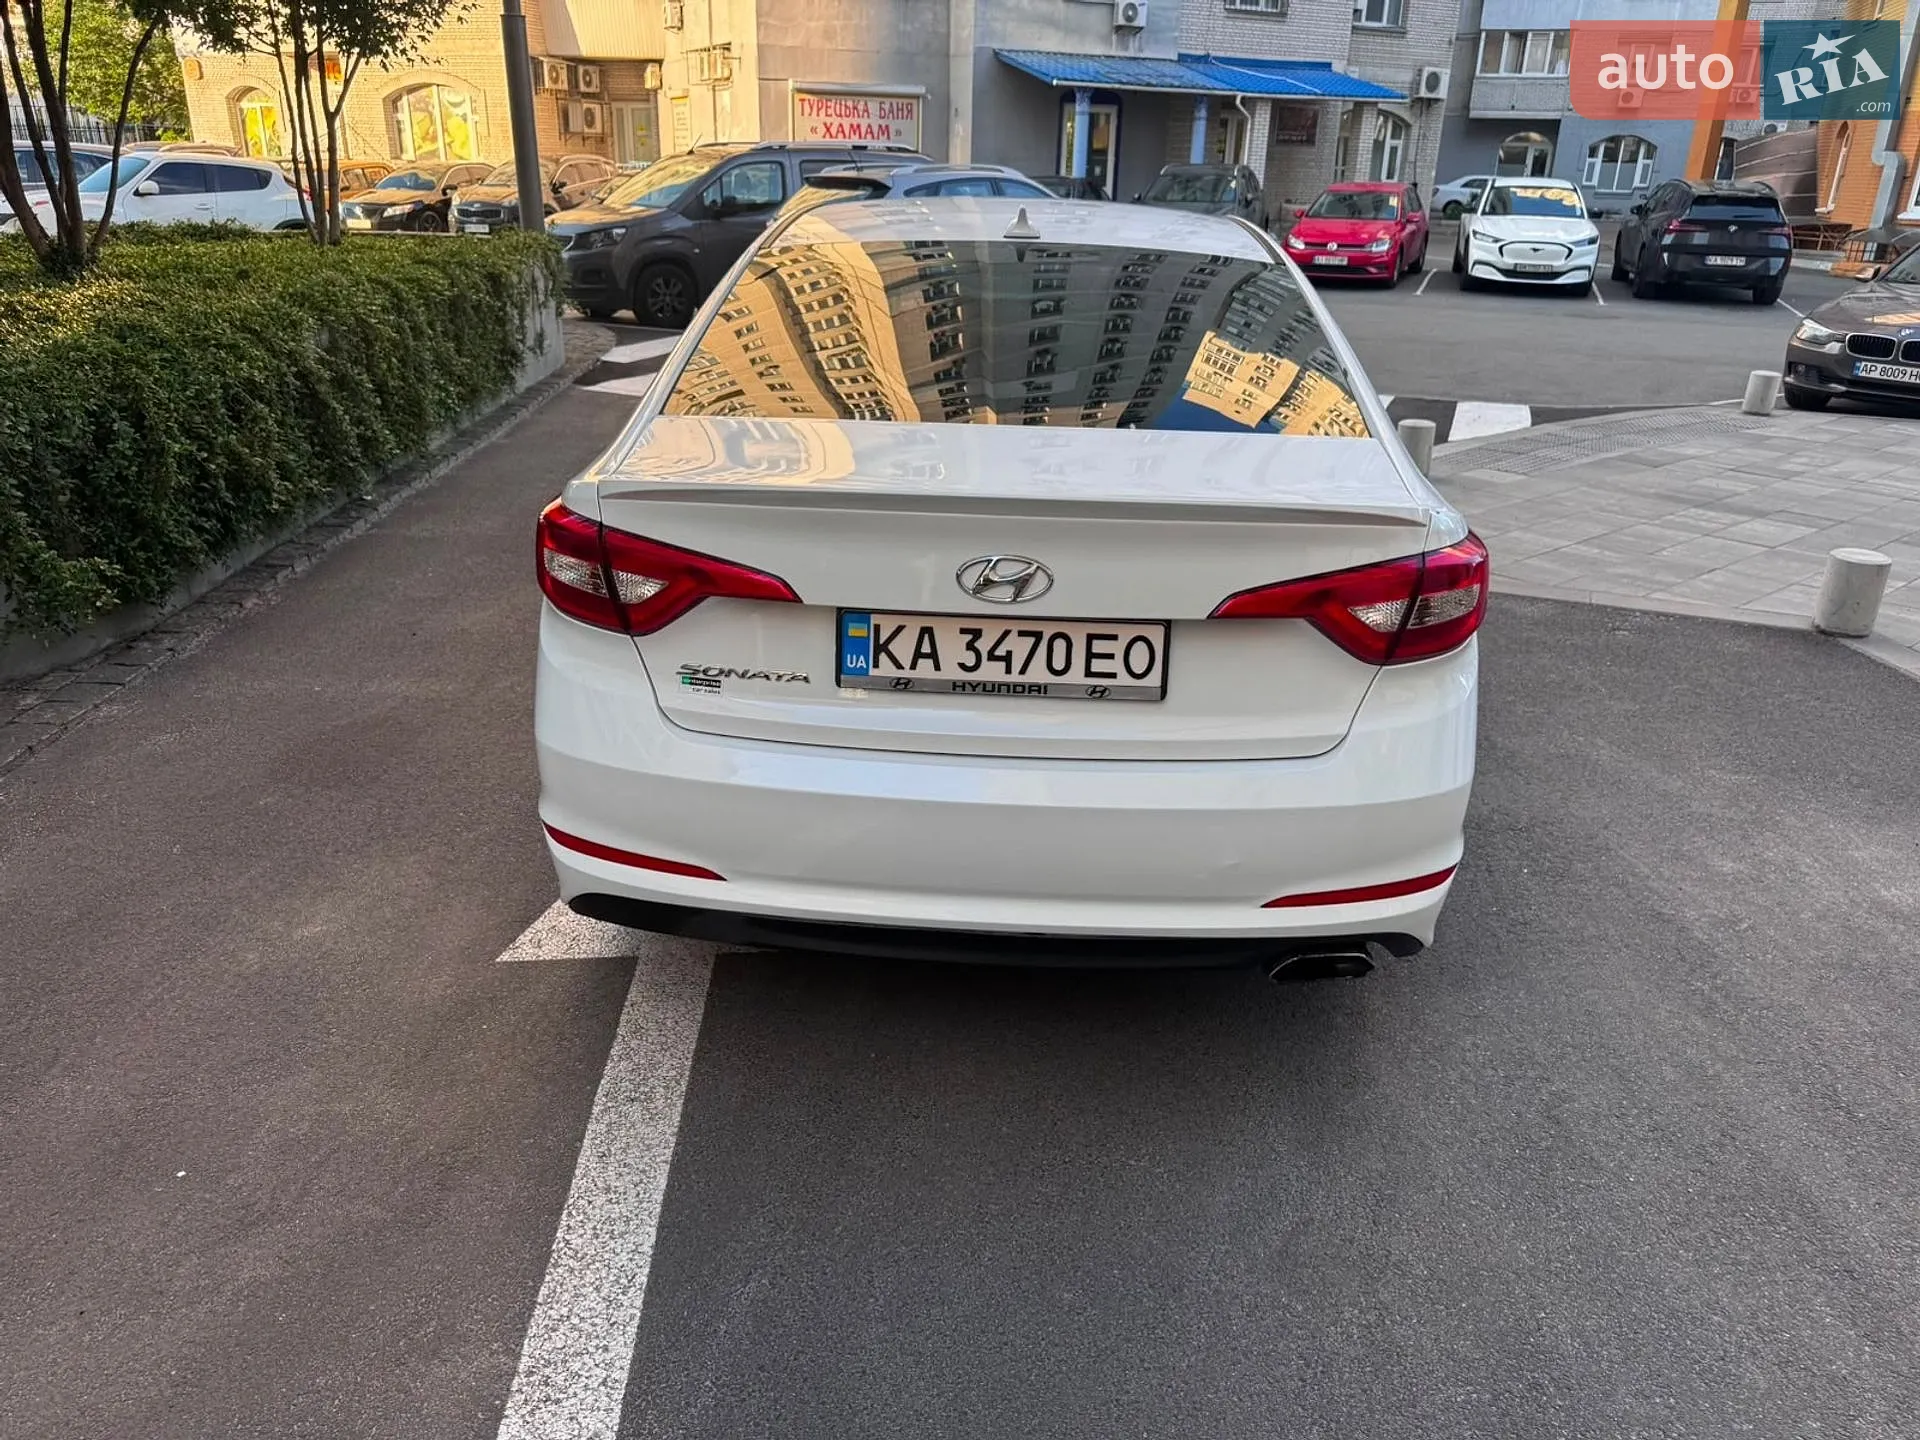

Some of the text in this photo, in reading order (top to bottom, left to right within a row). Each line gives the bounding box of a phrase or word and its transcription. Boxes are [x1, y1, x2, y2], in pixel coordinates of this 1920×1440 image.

[798, 98, 914, 121] ТУРЕЦЬКА БАНЯ
[1861, 363, 1920, 382] AP 8009 H
[847, 653, 867, 669] UA
[872, 623, 1156, 681] KA 3470 EO
[675, 663, 811, 684] SONATA
[951, 681, 1049, 696] HYUNDAI
